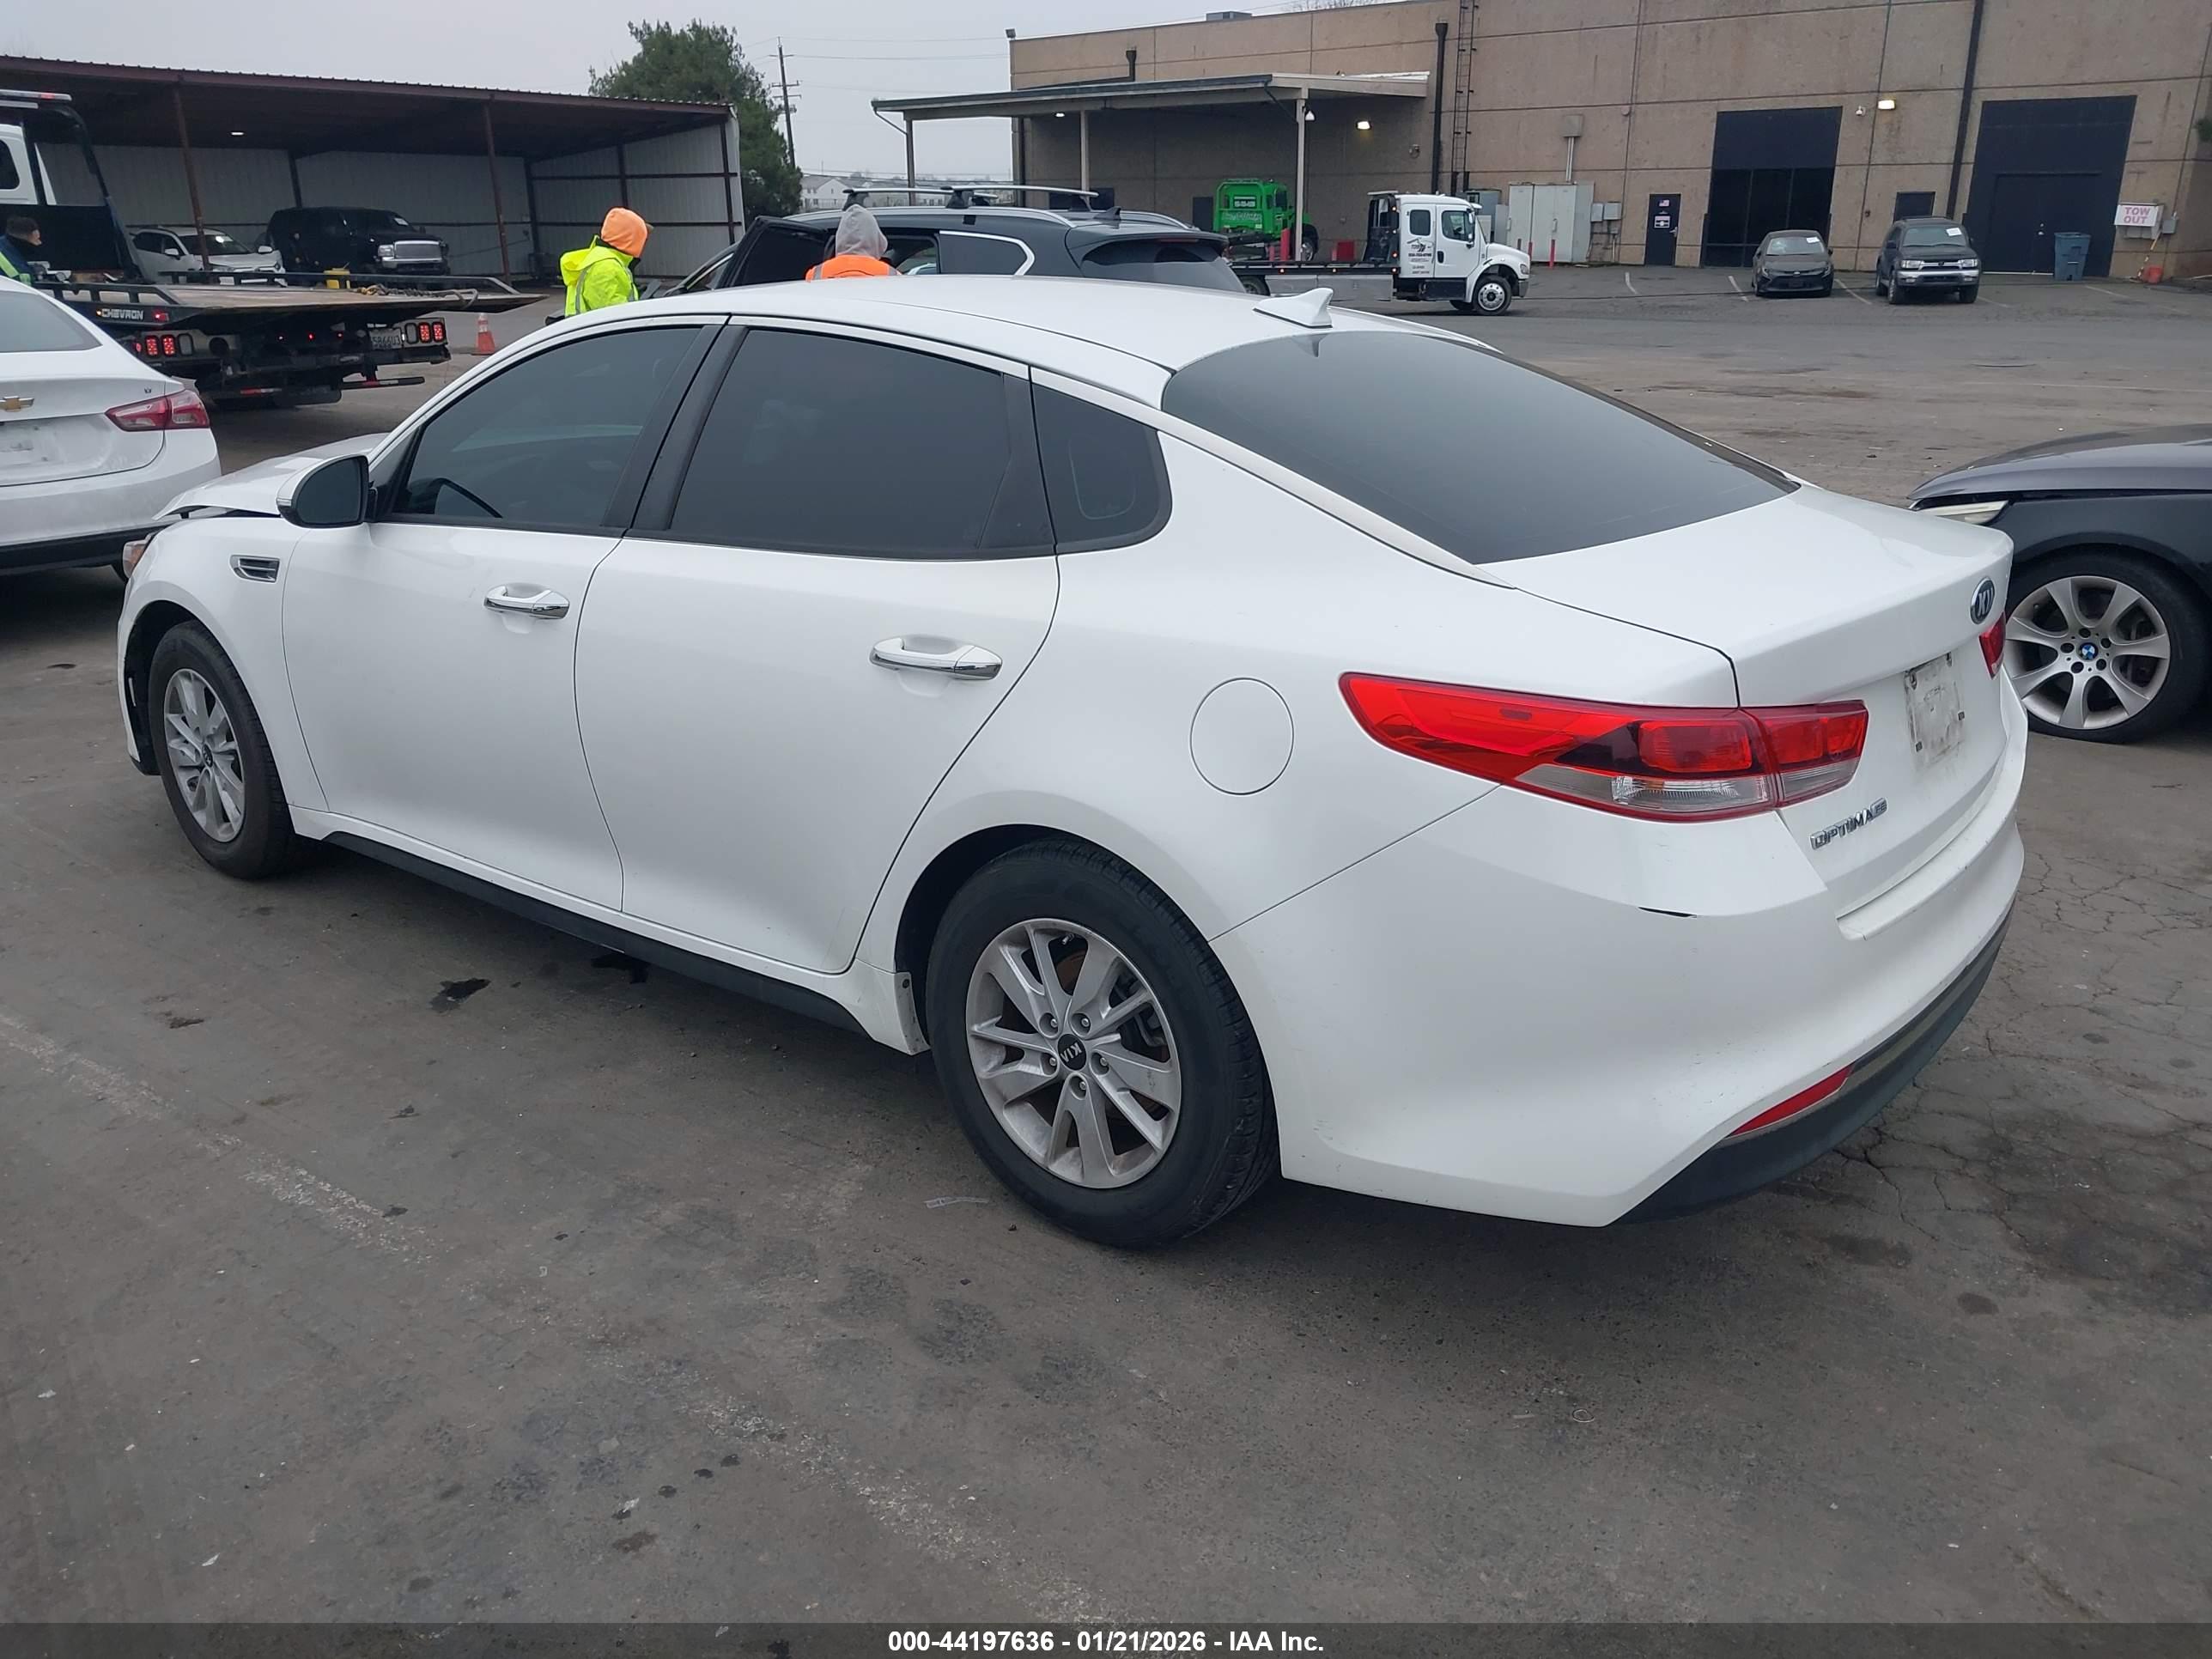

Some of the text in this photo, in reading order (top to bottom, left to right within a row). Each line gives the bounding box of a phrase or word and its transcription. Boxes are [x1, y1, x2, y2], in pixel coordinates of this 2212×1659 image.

[2124, 207, 2150, 216] TOW
[2124, 216, 2148, 224] OUT
[101, 308, 144, 320] CHEVRON
[1810, 807, 1873, 850] OPTIMA
[1060, 1042, 1082, 1063] KIA
